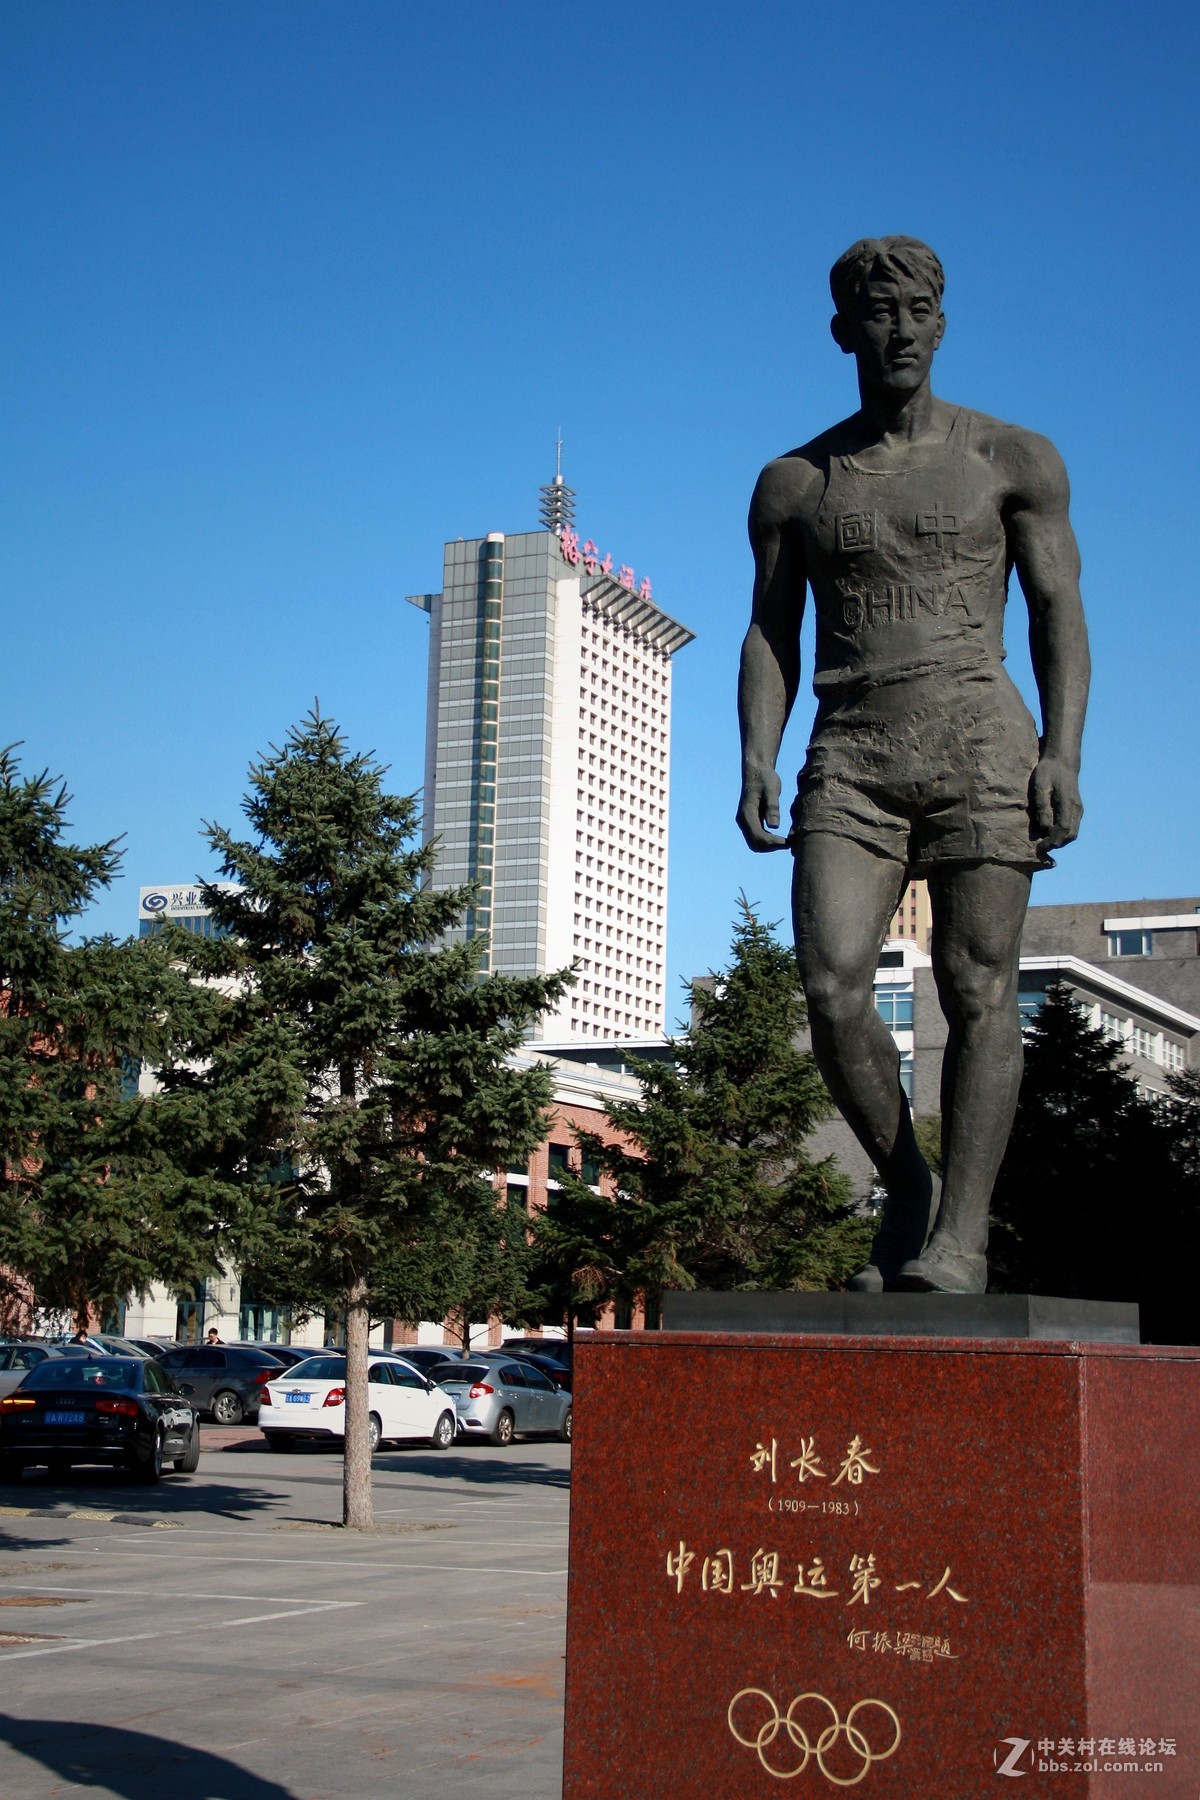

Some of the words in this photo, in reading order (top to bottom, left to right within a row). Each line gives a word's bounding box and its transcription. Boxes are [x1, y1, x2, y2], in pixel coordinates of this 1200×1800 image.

[841, 582, 973, 630] CHINA
[749, 1434, 880, 1486] 刘长春
[666, 1540, 969, 1606] 中国奥运第一人
